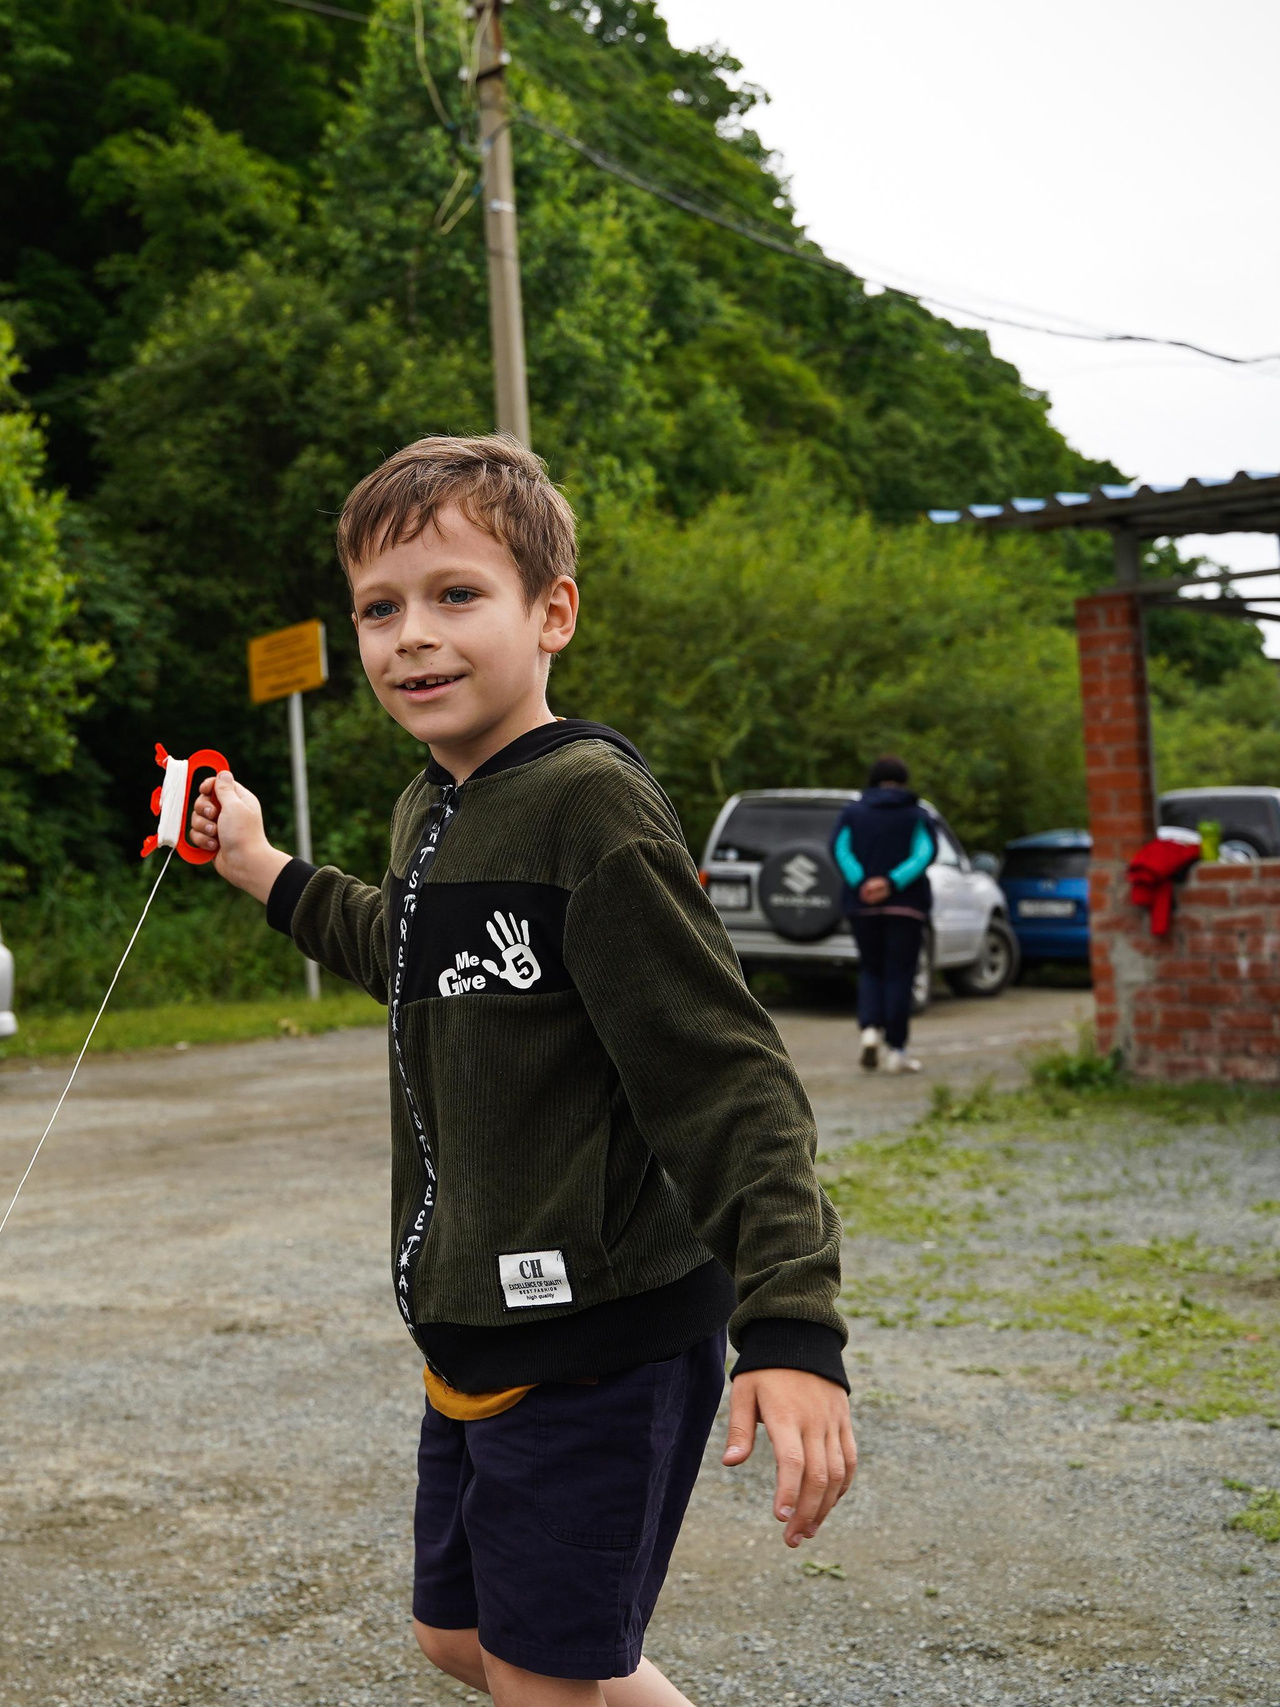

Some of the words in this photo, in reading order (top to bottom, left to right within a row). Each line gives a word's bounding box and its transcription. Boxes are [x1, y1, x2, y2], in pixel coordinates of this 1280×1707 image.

[457, 951, 480, 971] Me
[512, 952, 535, 980] 5
[438, 968, 487, 997] Give
[519, 1259, 544, 1279] CH
[508, 1281, 537, 1290] EXCELLENCE
